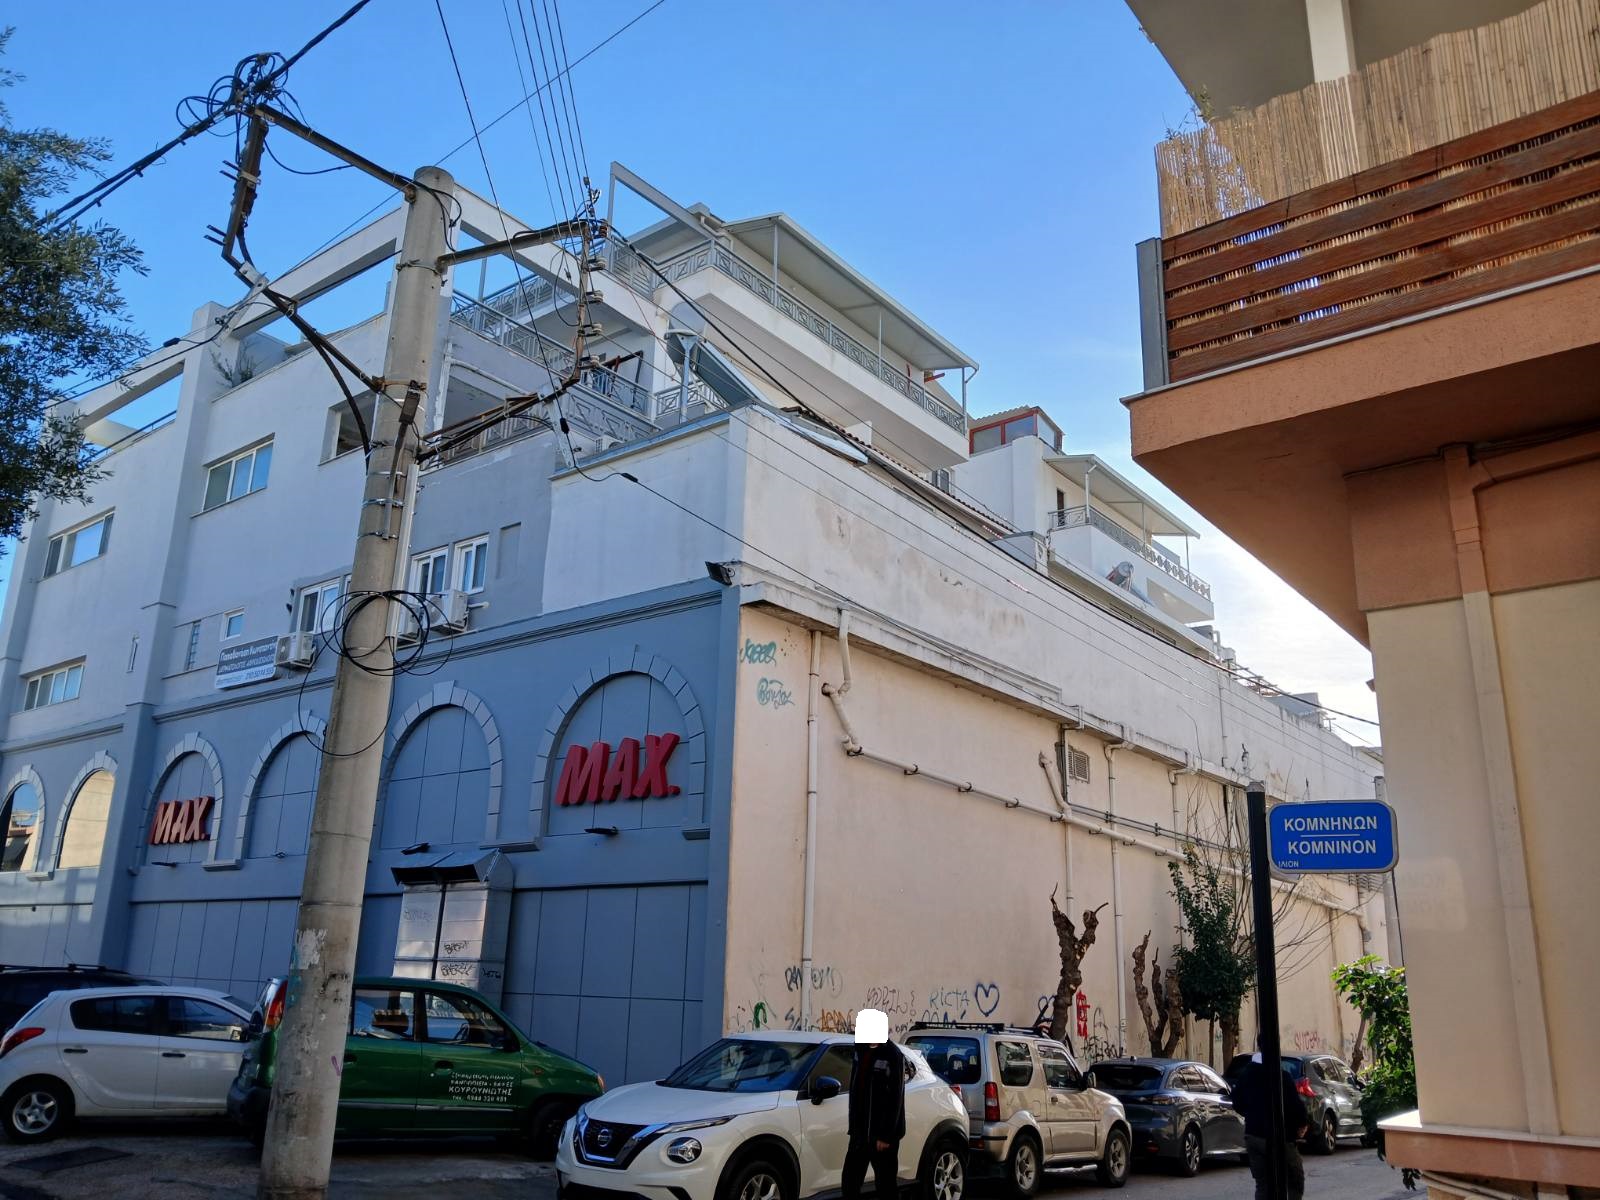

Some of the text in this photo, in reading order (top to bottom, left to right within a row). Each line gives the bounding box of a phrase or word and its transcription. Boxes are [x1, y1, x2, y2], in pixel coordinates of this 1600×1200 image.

[1284, 815, 1378, 832] ΚΟΜΝΗΝΩΝ
[1288, 839, 1376, 855] KOMNINON
[449, 1086, 512, 1095] ΚΟΥΡΟΥΝΙΩΤΗΣ
